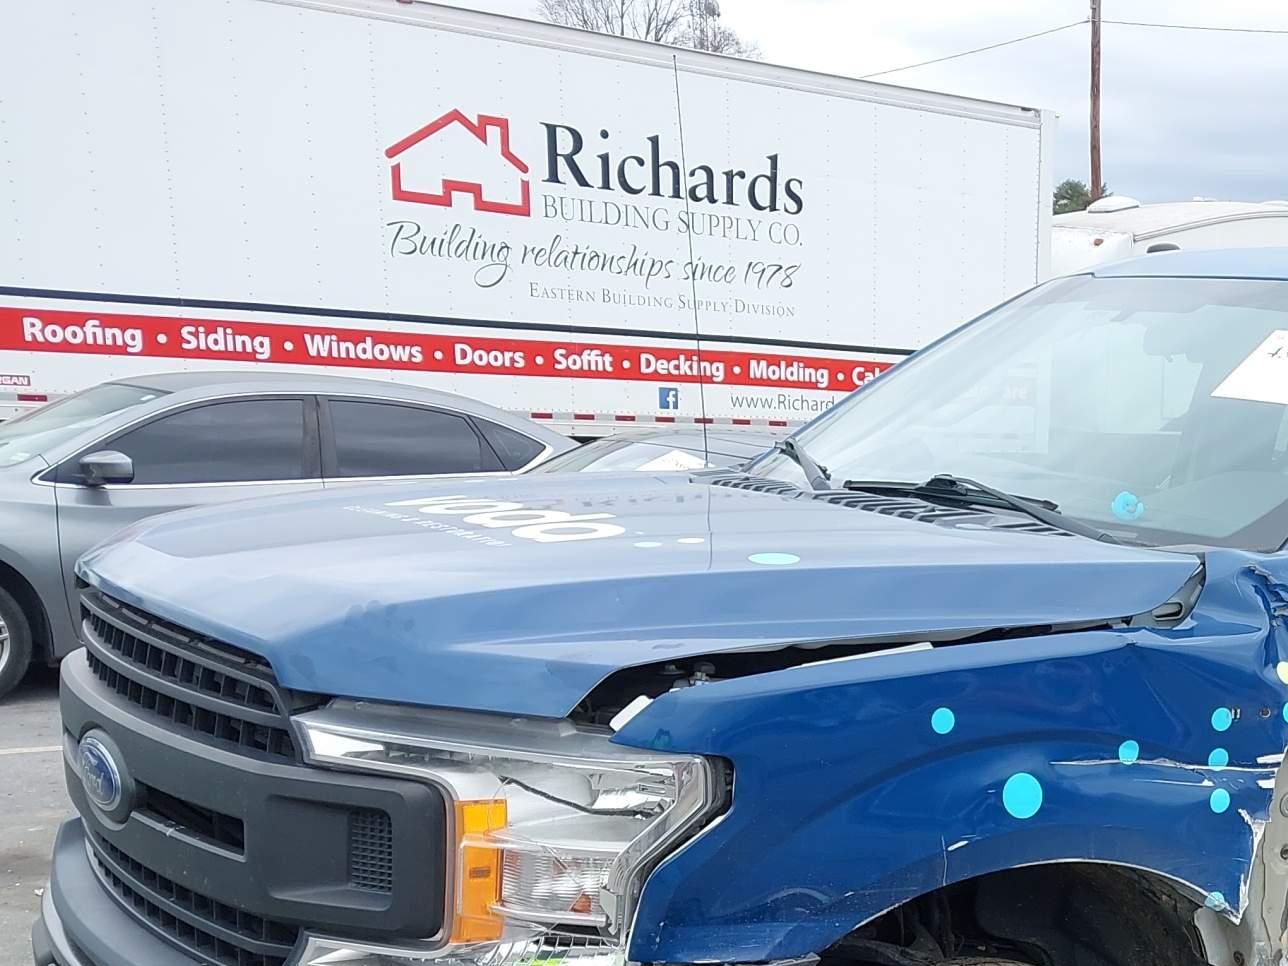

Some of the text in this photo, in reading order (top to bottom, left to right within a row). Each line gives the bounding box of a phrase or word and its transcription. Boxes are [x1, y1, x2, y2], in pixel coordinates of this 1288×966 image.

[539, 121, 803, 215] Richards
[543, 194, 803, 246] BUILDING SUPPLY CO.
[386, 220, 801, 290] Building relationships since 1978
[529, 281, 795, 317] EASTERN BUILDING SUPPLY DIVISION
[0, 375, 29, 385] GAN
[22, 316, 143, 353] Roofing
[180, 325, 271, 359] Siding
[303, 333, 423, 363] Windows
[454, 343, 525, 368] Doors
[553, 348, 614, 372] Soffit
[640, 353, 725, 382] Decking
[749, 359, 829, 388] Molding
